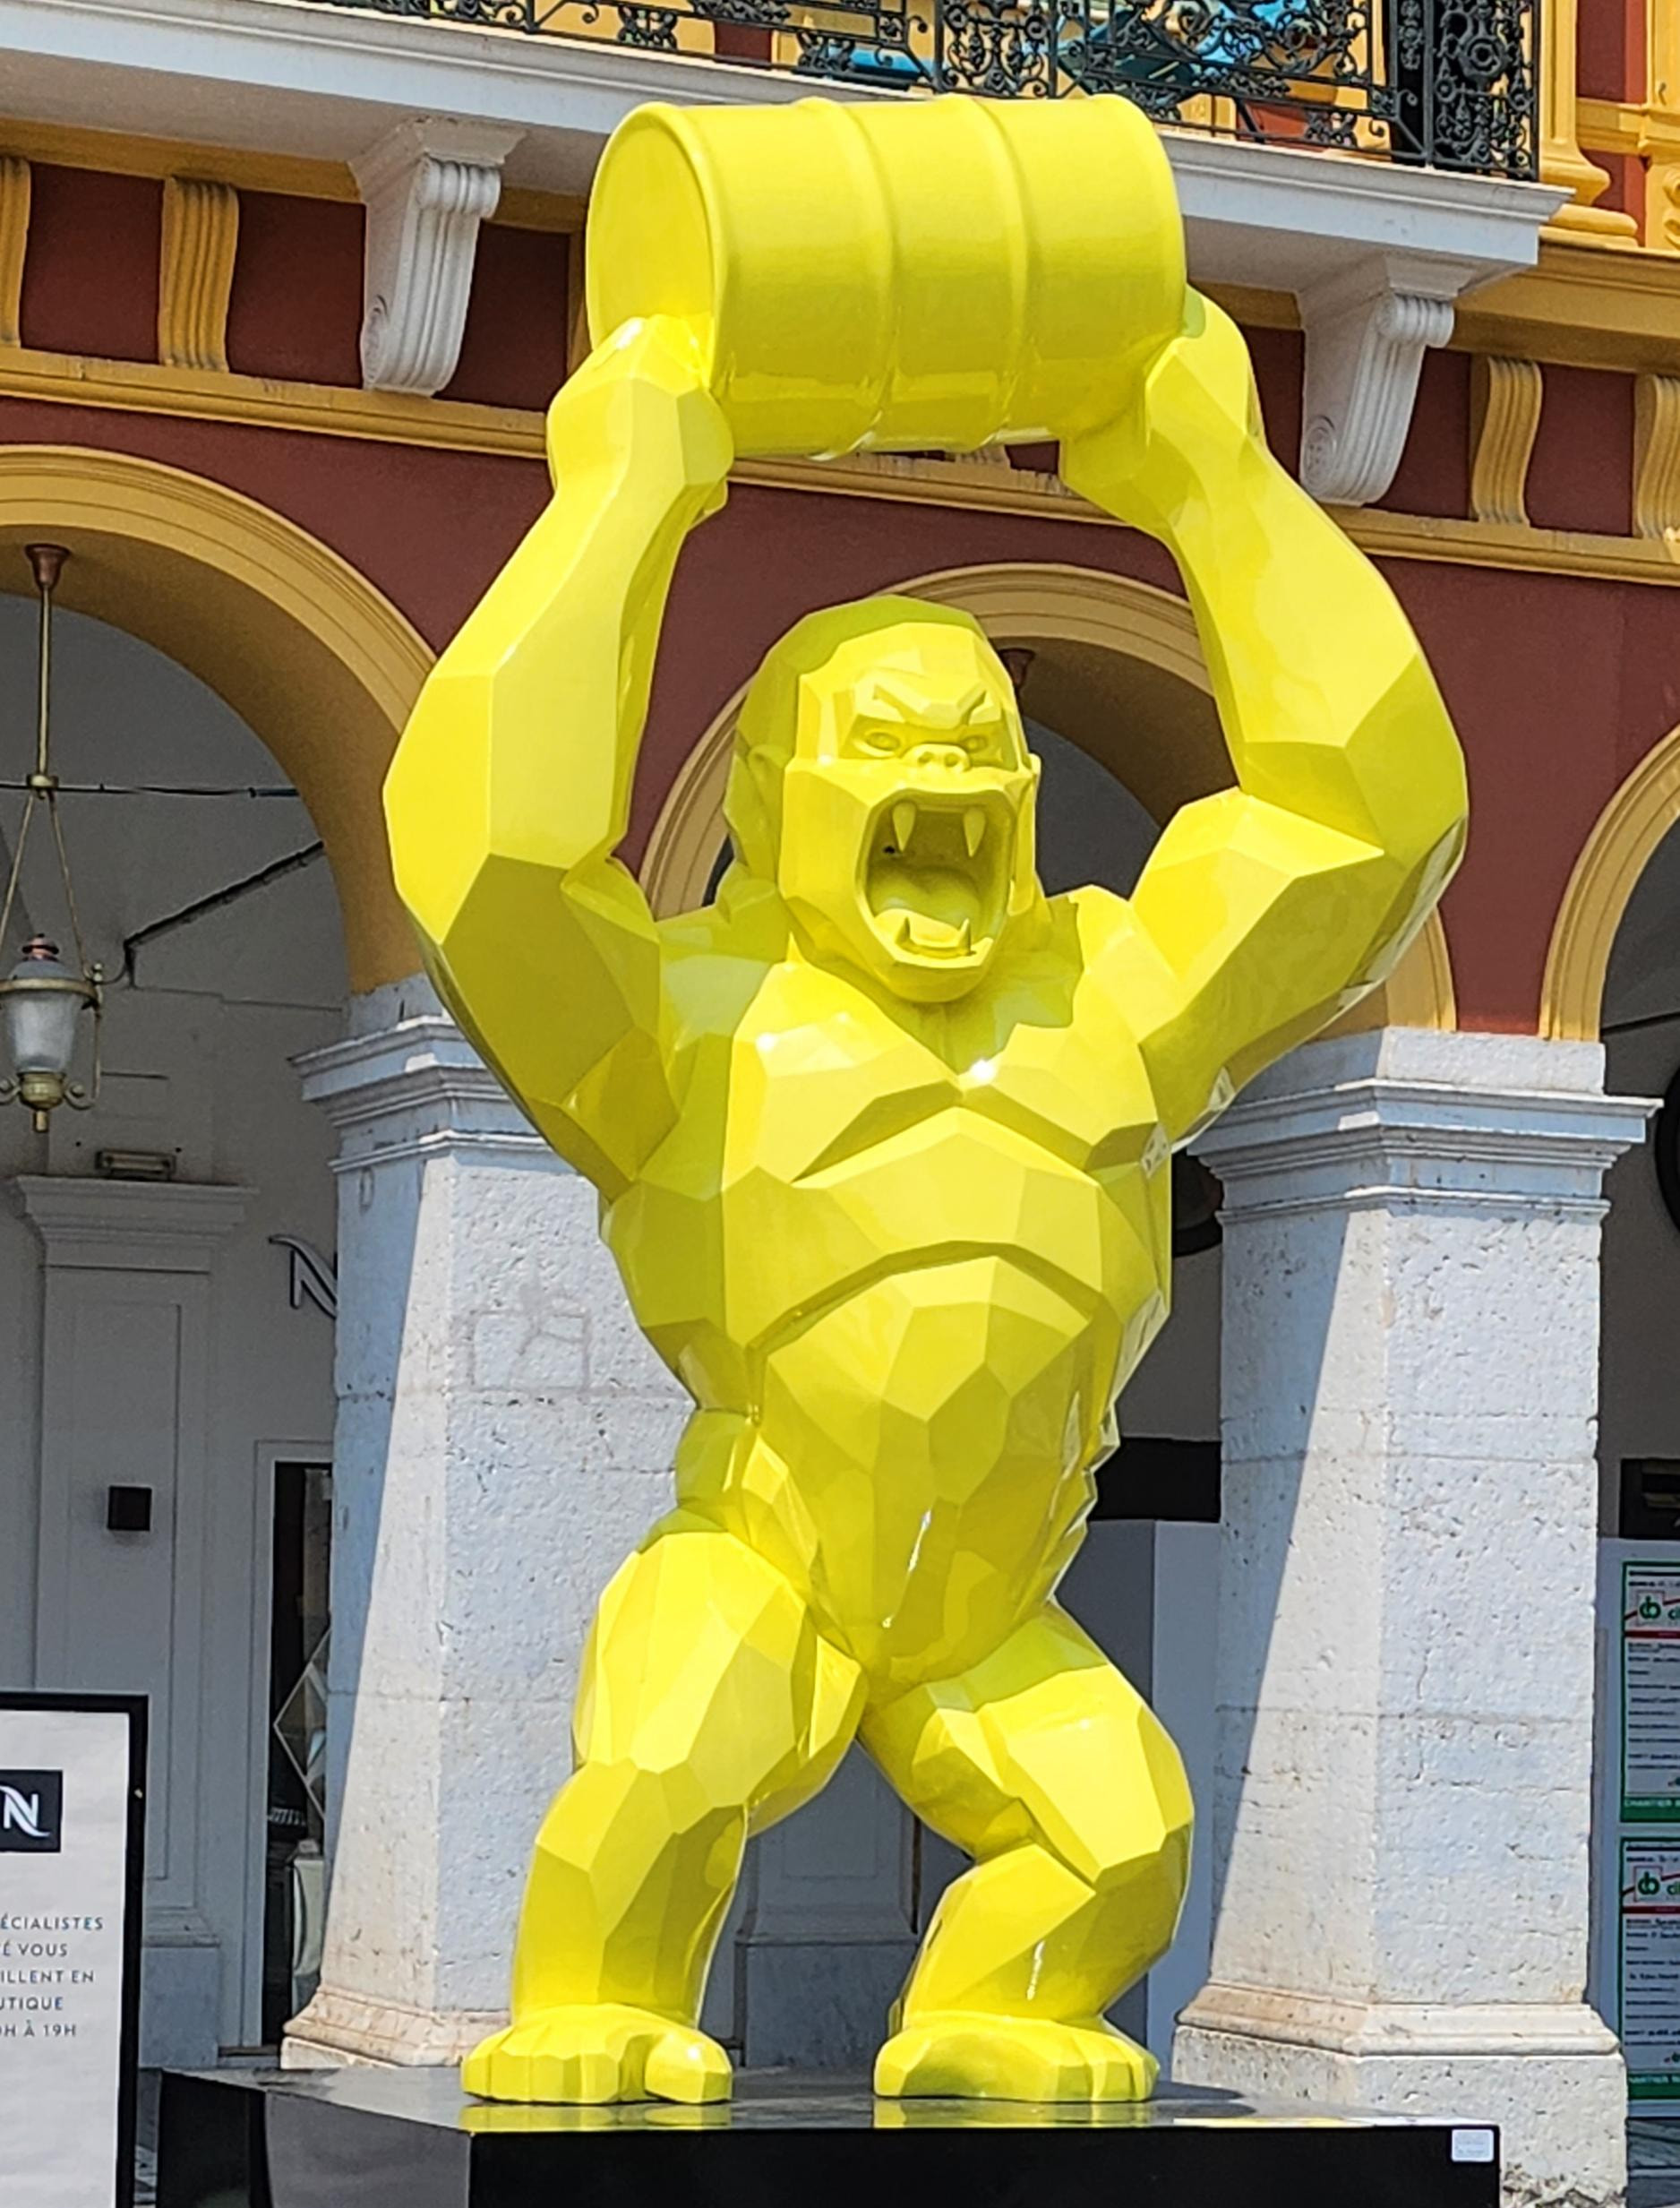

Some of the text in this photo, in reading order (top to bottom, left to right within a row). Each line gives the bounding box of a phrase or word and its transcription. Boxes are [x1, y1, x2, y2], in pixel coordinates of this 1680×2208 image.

[0, 1785, 51, 1838] N
[0, 1912, 104, 1931] ÉCIALISTES
[18, 1942, 68, 1957] VOUS
[1, 1970, 94, 1984] ILLENT EN
[23, 2019, 36, 2038] À
[43, 2023, 77, 2038] 19H
